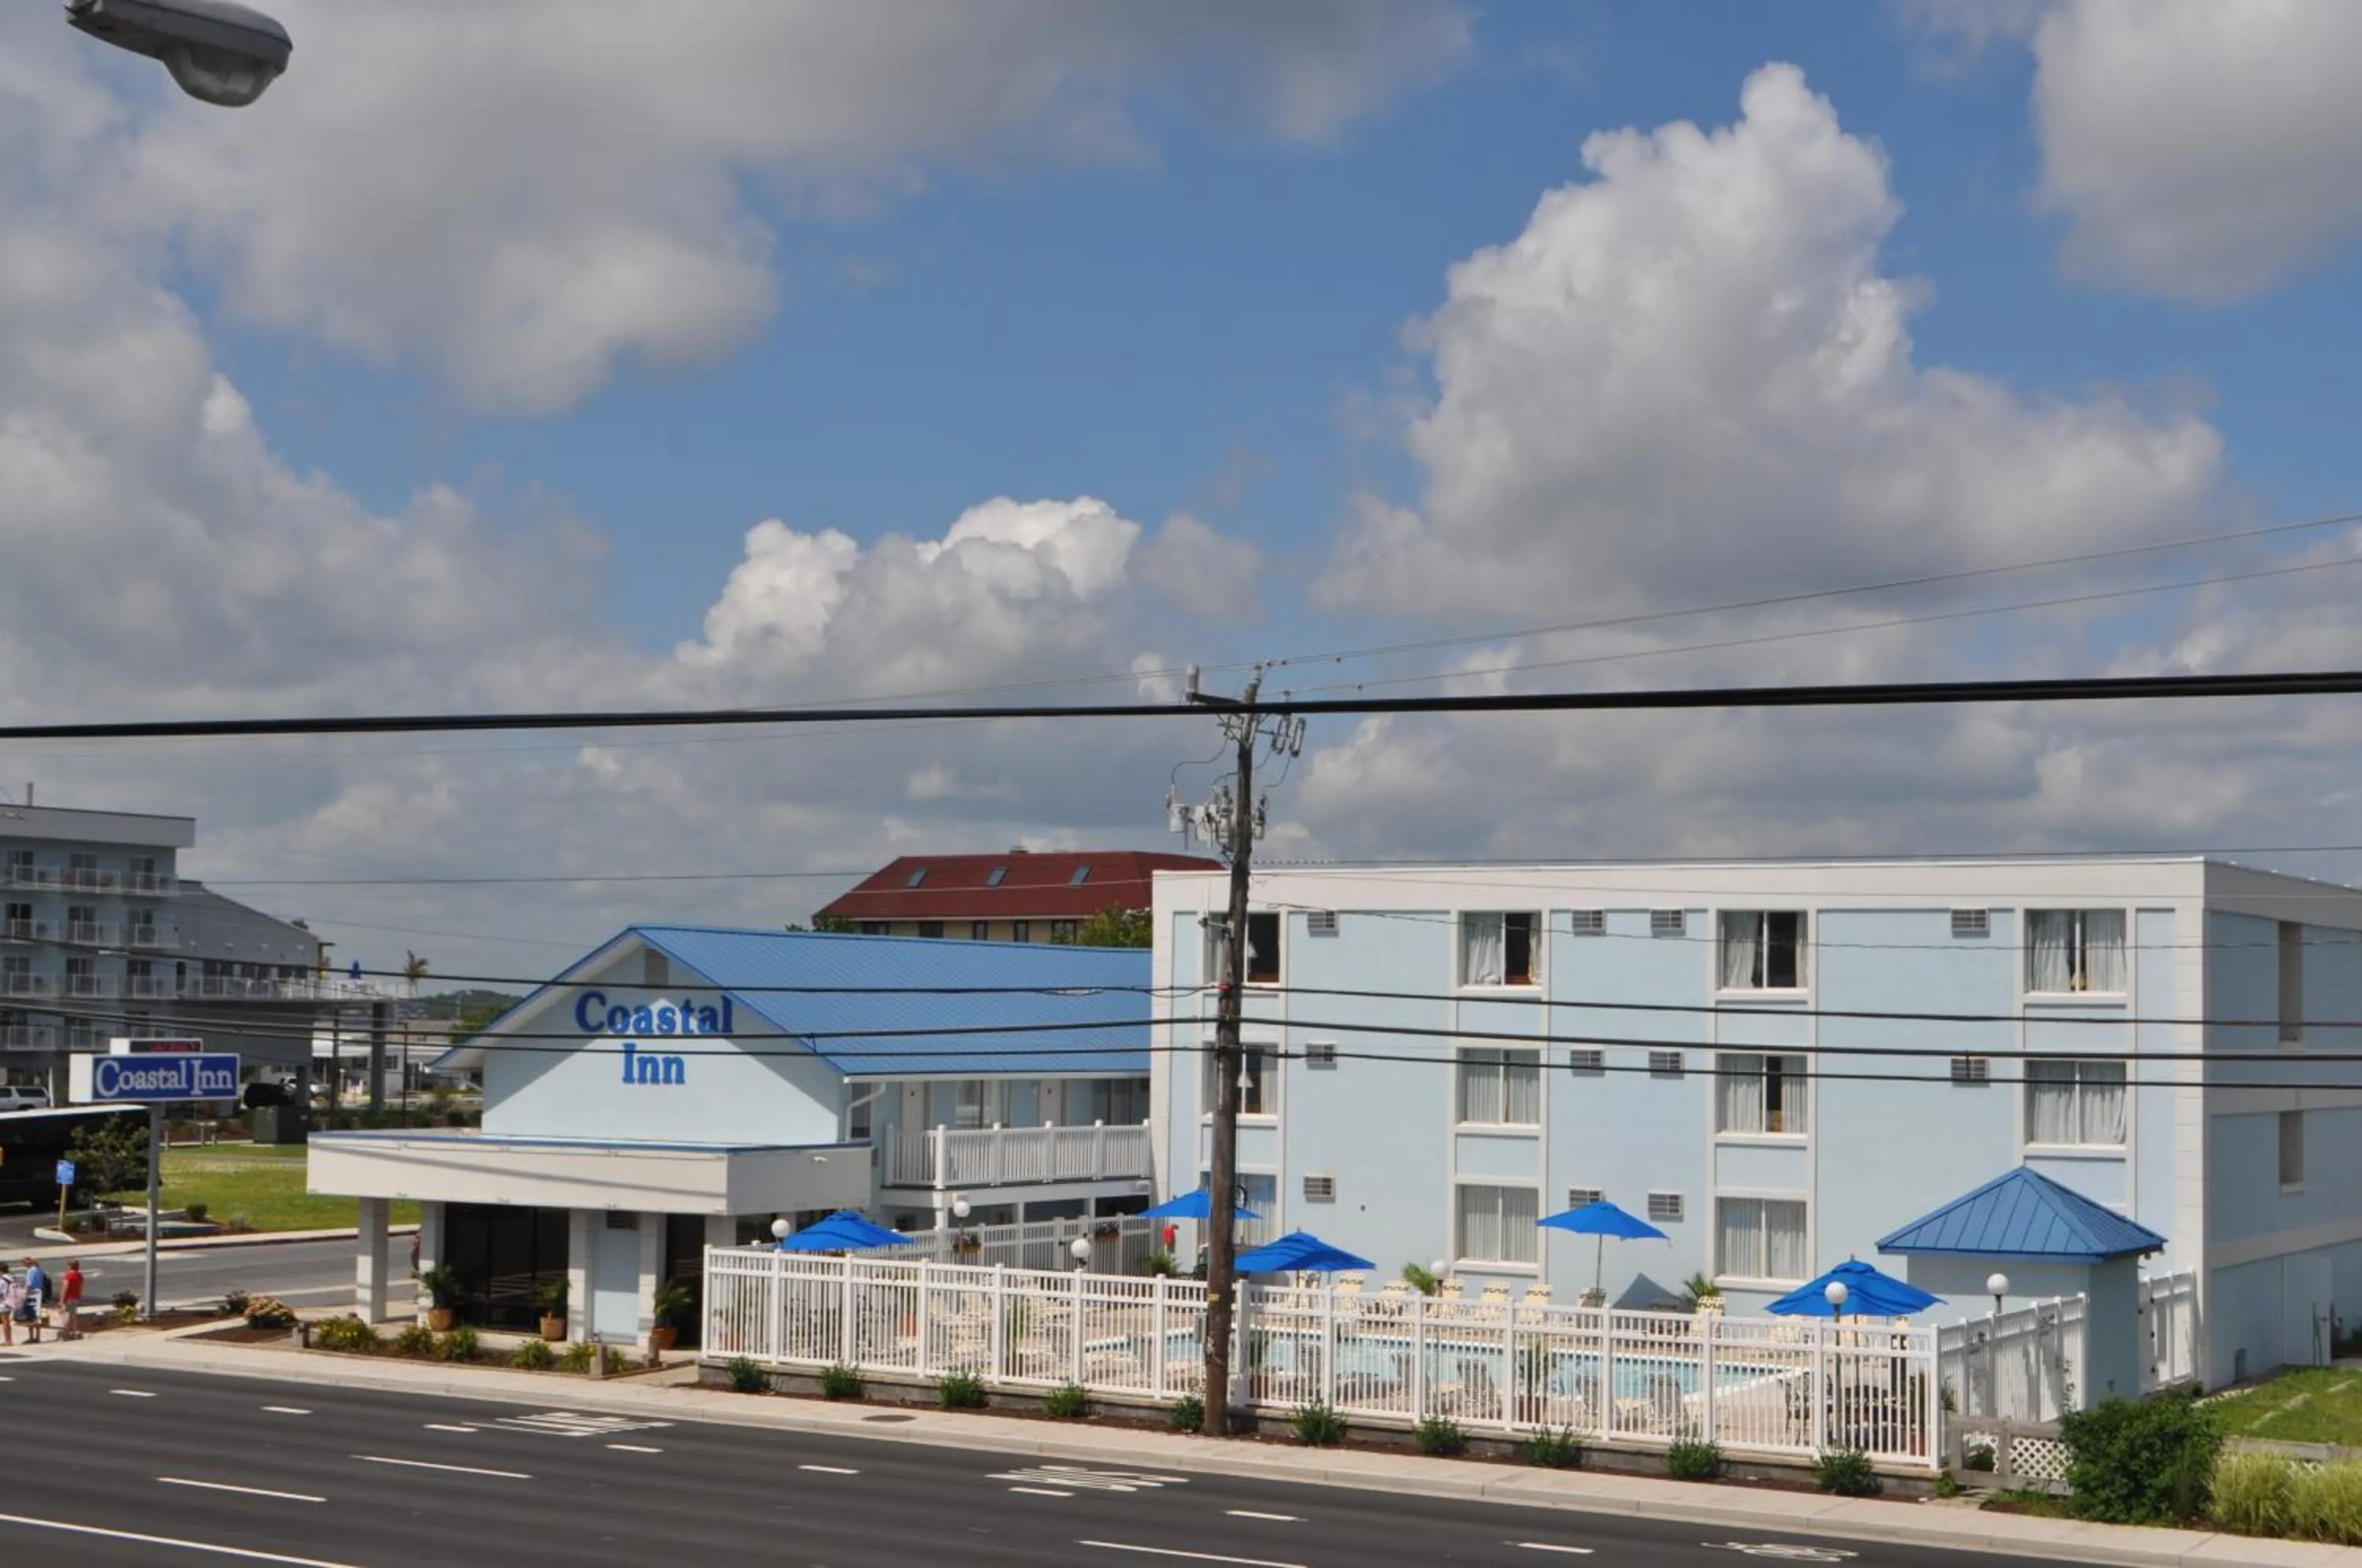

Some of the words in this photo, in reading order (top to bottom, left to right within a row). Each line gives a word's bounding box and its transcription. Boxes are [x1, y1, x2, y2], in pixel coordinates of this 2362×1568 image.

[576, 990, 733, 1034] Coastal
[96, 1059, 188, 1097] Coastal
[190, 1059, 234, 1096] Inn
[622, 1042, 686, 1085] Inn
